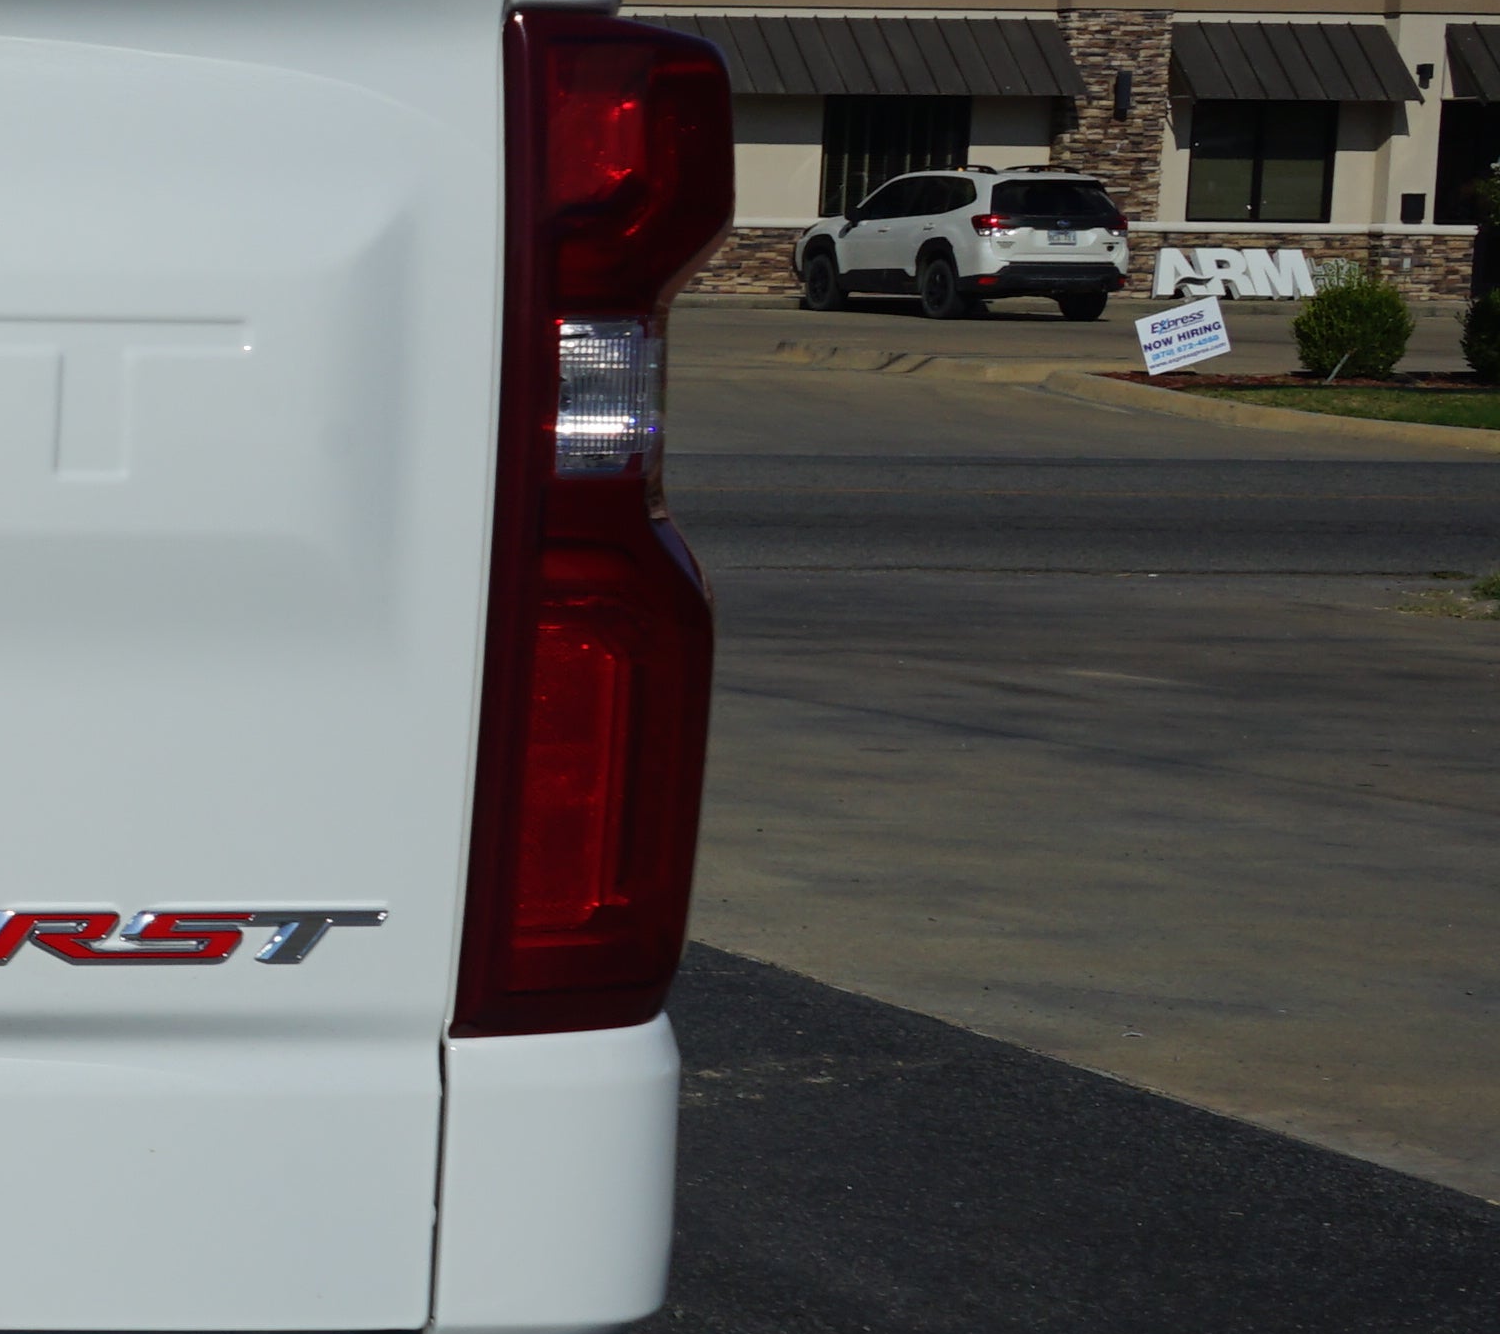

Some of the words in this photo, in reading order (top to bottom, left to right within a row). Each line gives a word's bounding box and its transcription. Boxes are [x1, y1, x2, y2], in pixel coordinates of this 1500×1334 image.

[1153, 247, 1316, 299] ARM
[1143, 336, 1173, 352] NOW
[1177, 322, 1222, 342] HIRING
